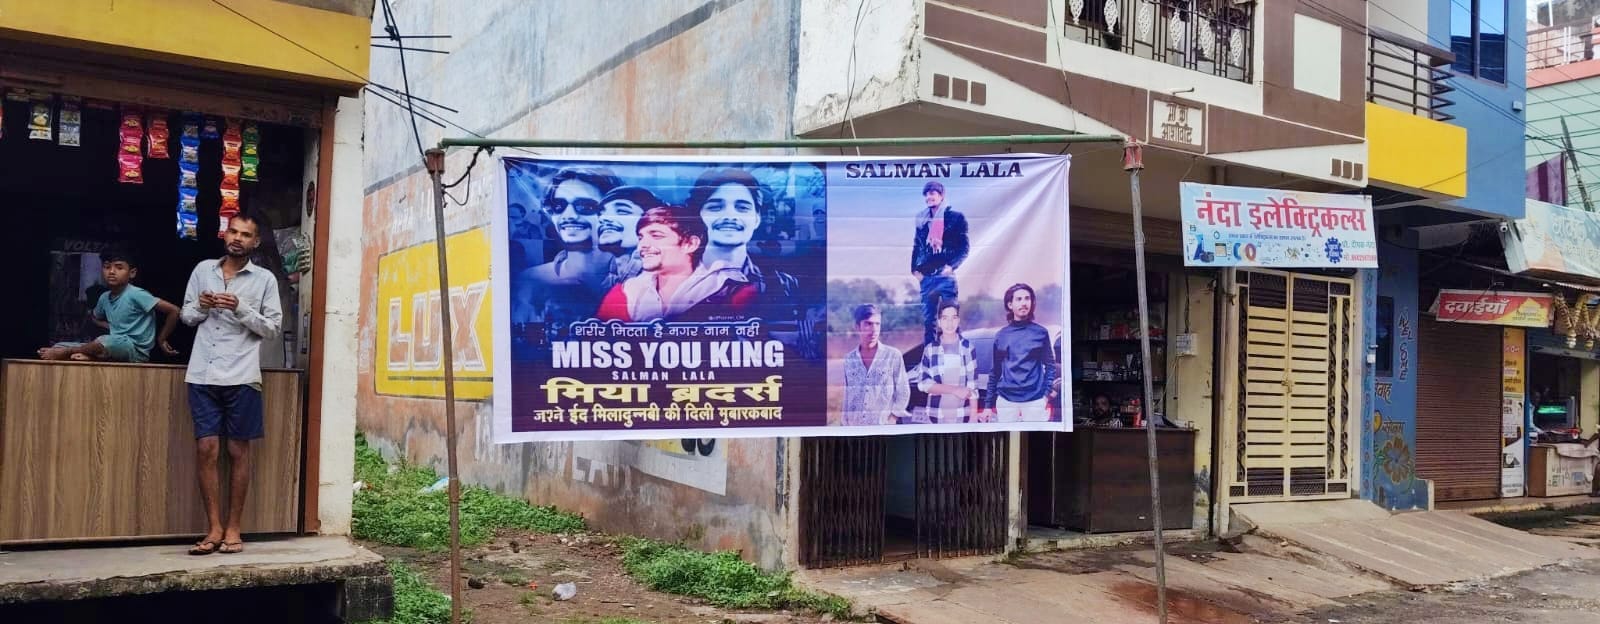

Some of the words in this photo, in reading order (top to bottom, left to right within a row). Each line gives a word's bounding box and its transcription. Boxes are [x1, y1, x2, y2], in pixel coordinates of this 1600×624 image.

[846, 162, 950, 178] SALMAN
[959, 161, 1024, 178] LALA
[1195, 192, 1241, 228] नंदा
[1247, 197, 1367, 237] इलेक्ट्रिकल्स
[387, 281, 490, 372] LUX
[575, 322, 605, 337] शरीर
[611, 322, 648, 337] मिटता
[654, 323, 664, 338] है
[669, 326, 699, 337] मगर
[704, 326, 730, 336] नाम
[552, 341, 633, 369] MISS
[639, 341, 702, 369] YOU
[710, 340, 784, 368] KING
[540, 376, 651, 404] मिया
[666, 375, 783, 403] ब्रदर्स
[612, 371, 669, 381] SALMAN
[682, 371, 715, 381] LALA
[568, 403, 588, 424] ईद
[592, 403, 660, 428] मिलादुन्नबी
[663, 402, 681, 420] की
[684, 402, 714, 420] दिली
[717, 406, 783, 426] मुबारकबाद
